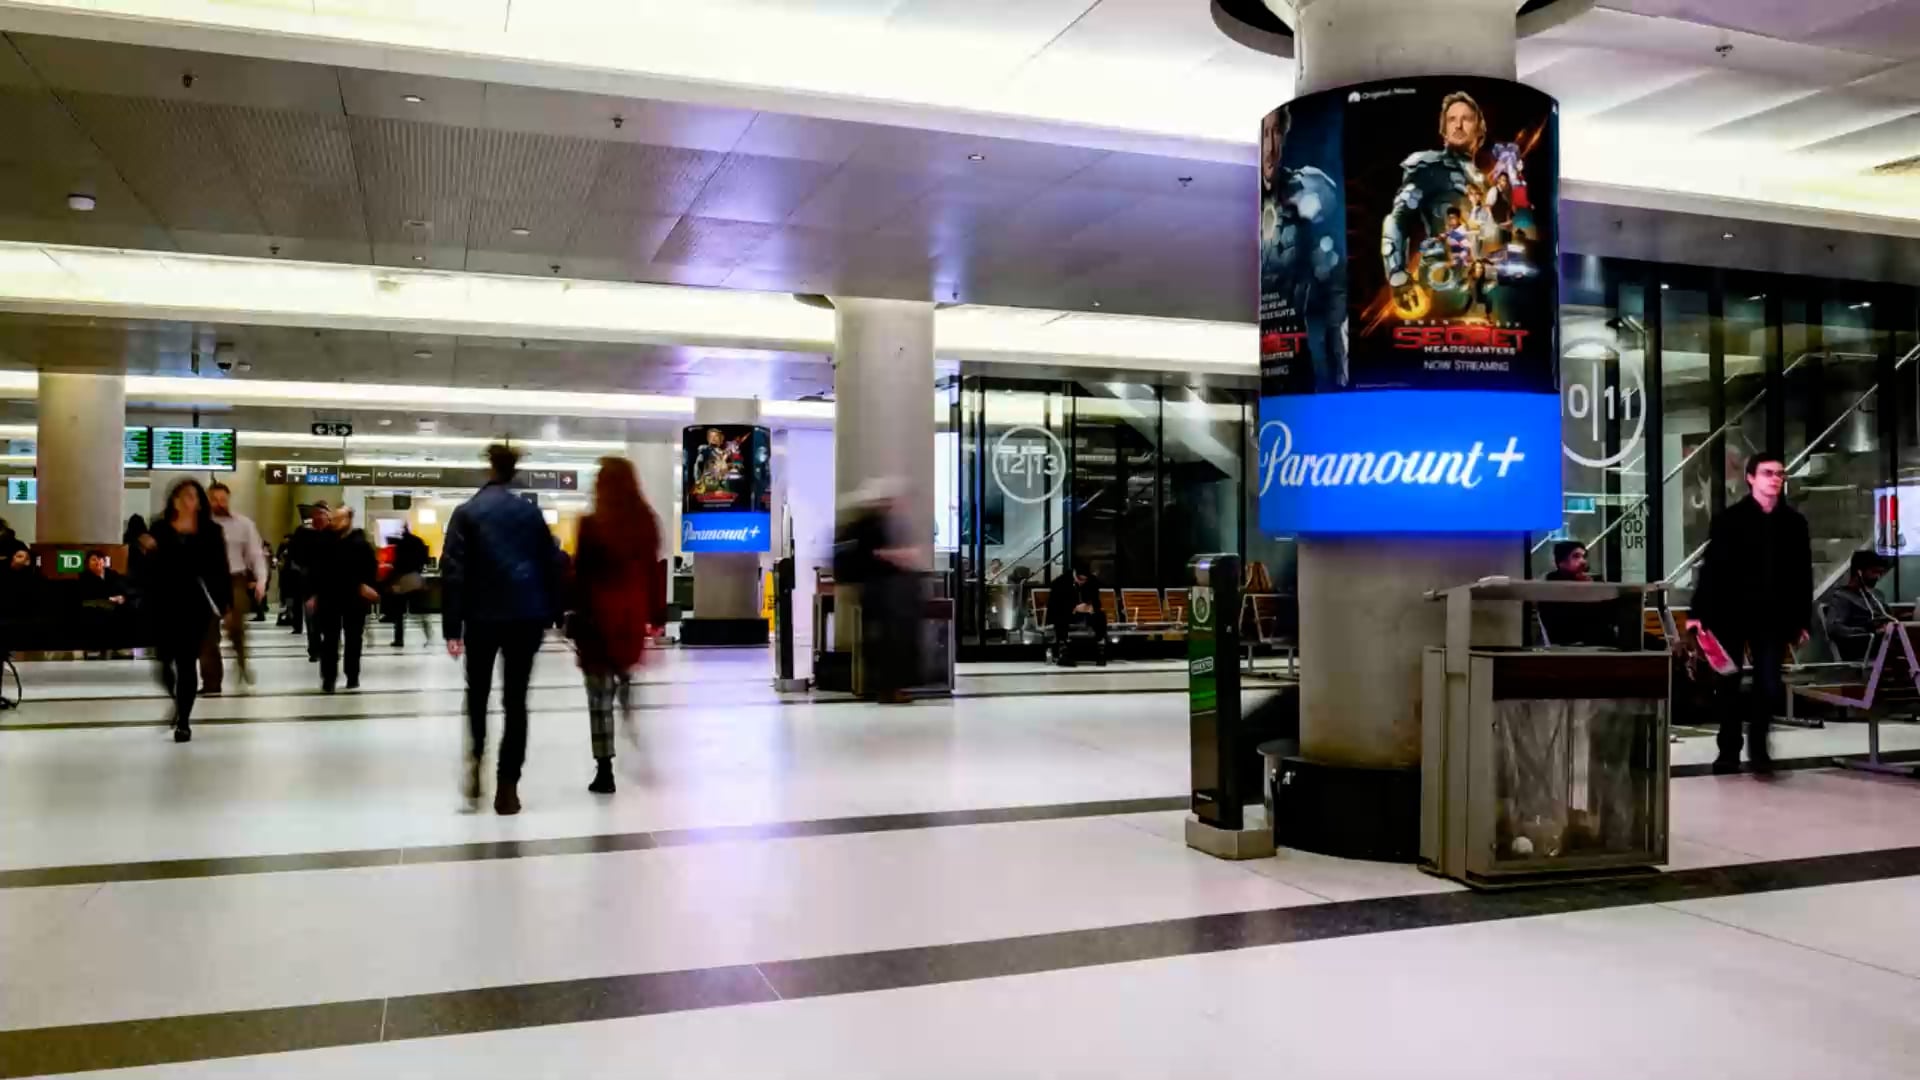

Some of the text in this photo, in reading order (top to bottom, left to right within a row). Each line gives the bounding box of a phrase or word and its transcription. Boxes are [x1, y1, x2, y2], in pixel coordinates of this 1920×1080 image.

[1392, 326, 1529, 352] SECRET
[1424, 345, 1517, 355] HEADQUARTERS
[1424, 360, 1510, 372] NOW STREAMING
[1603, 385, 1632, 420] 11
[1001, 453, 1059, 475] 12 13
[1259, 420, 1526, 497] Paramount+
[60, 553, 82, 569] TD
